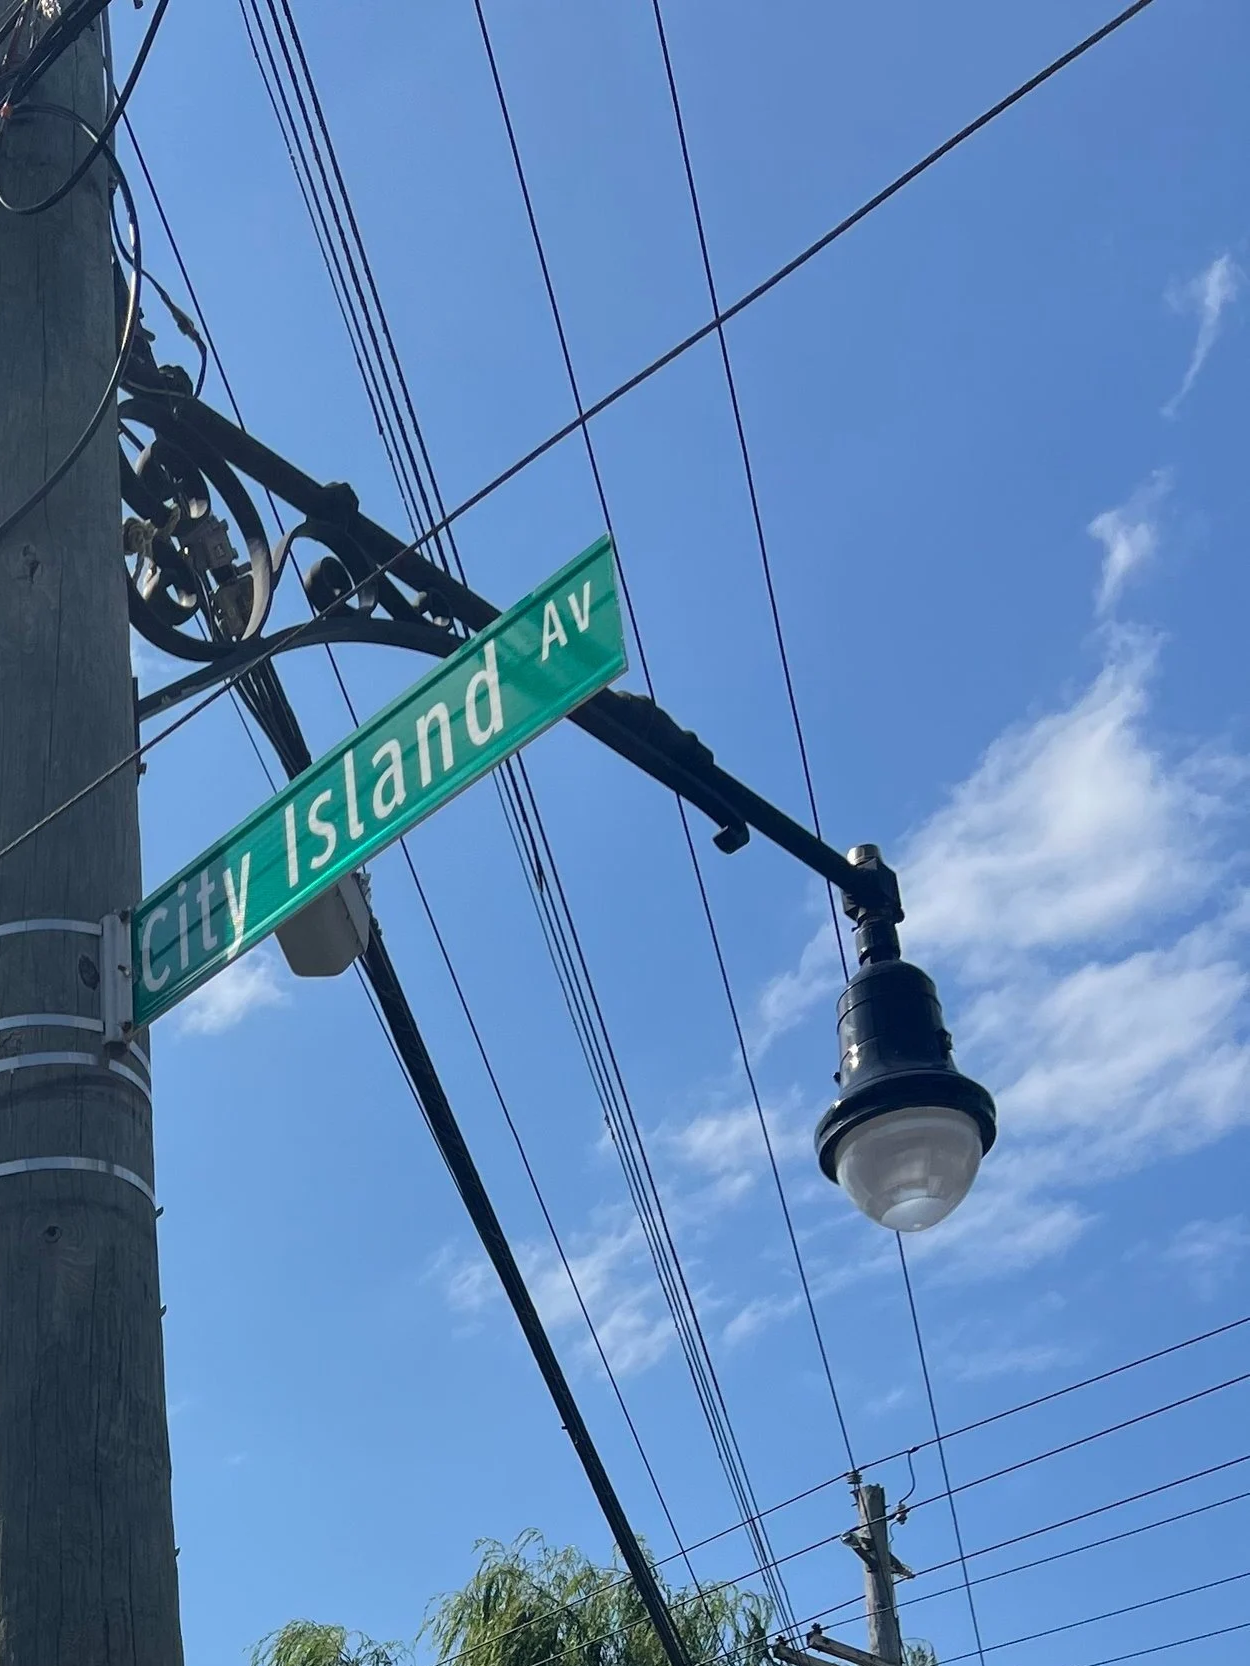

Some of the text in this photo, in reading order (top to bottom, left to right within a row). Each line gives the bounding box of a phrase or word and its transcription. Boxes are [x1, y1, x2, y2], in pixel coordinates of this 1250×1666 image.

[138, 580, 592, 993] City Island Av
